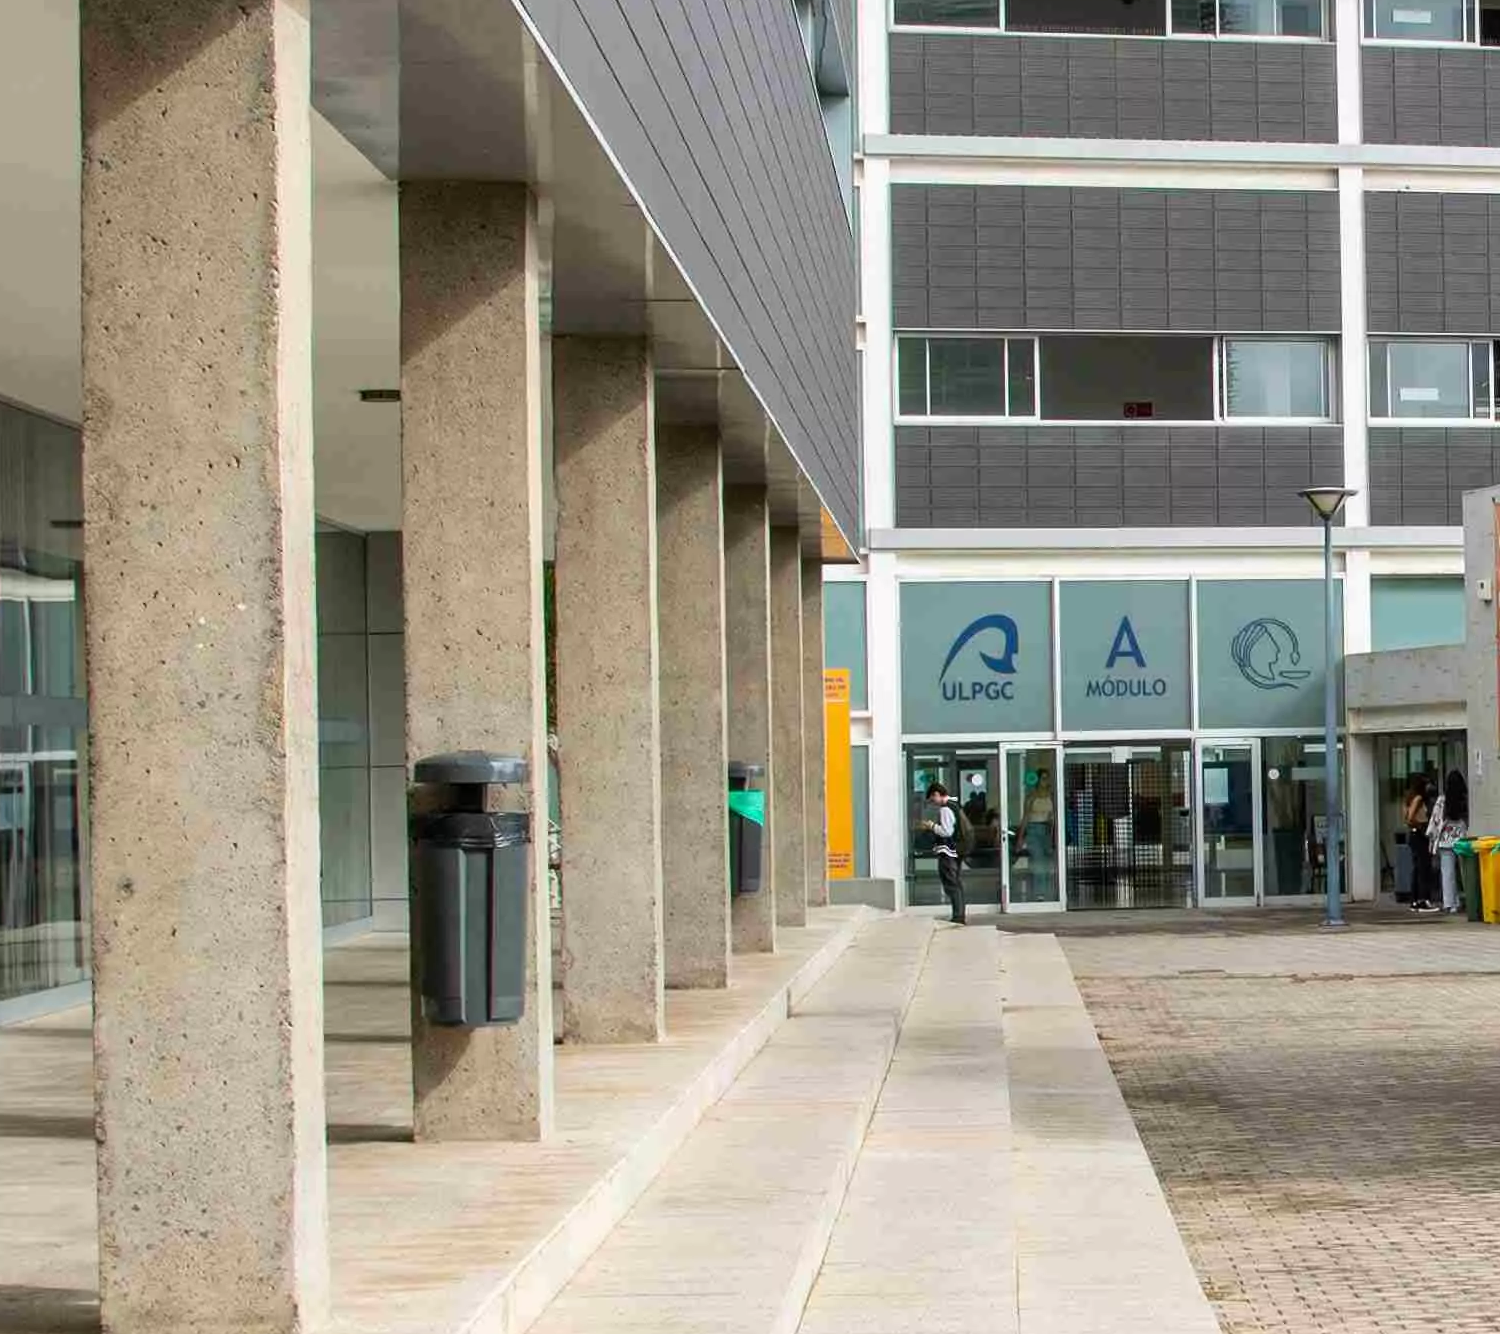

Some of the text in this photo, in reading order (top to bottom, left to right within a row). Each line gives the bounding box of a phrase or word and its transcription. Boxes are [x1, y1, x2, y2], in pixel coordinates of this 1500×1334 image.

[1105, 615, 1147, 668] A
[942, 680, 1015, 701] ULPGC
[1086, 675, 1167, 698] MÓDULO
